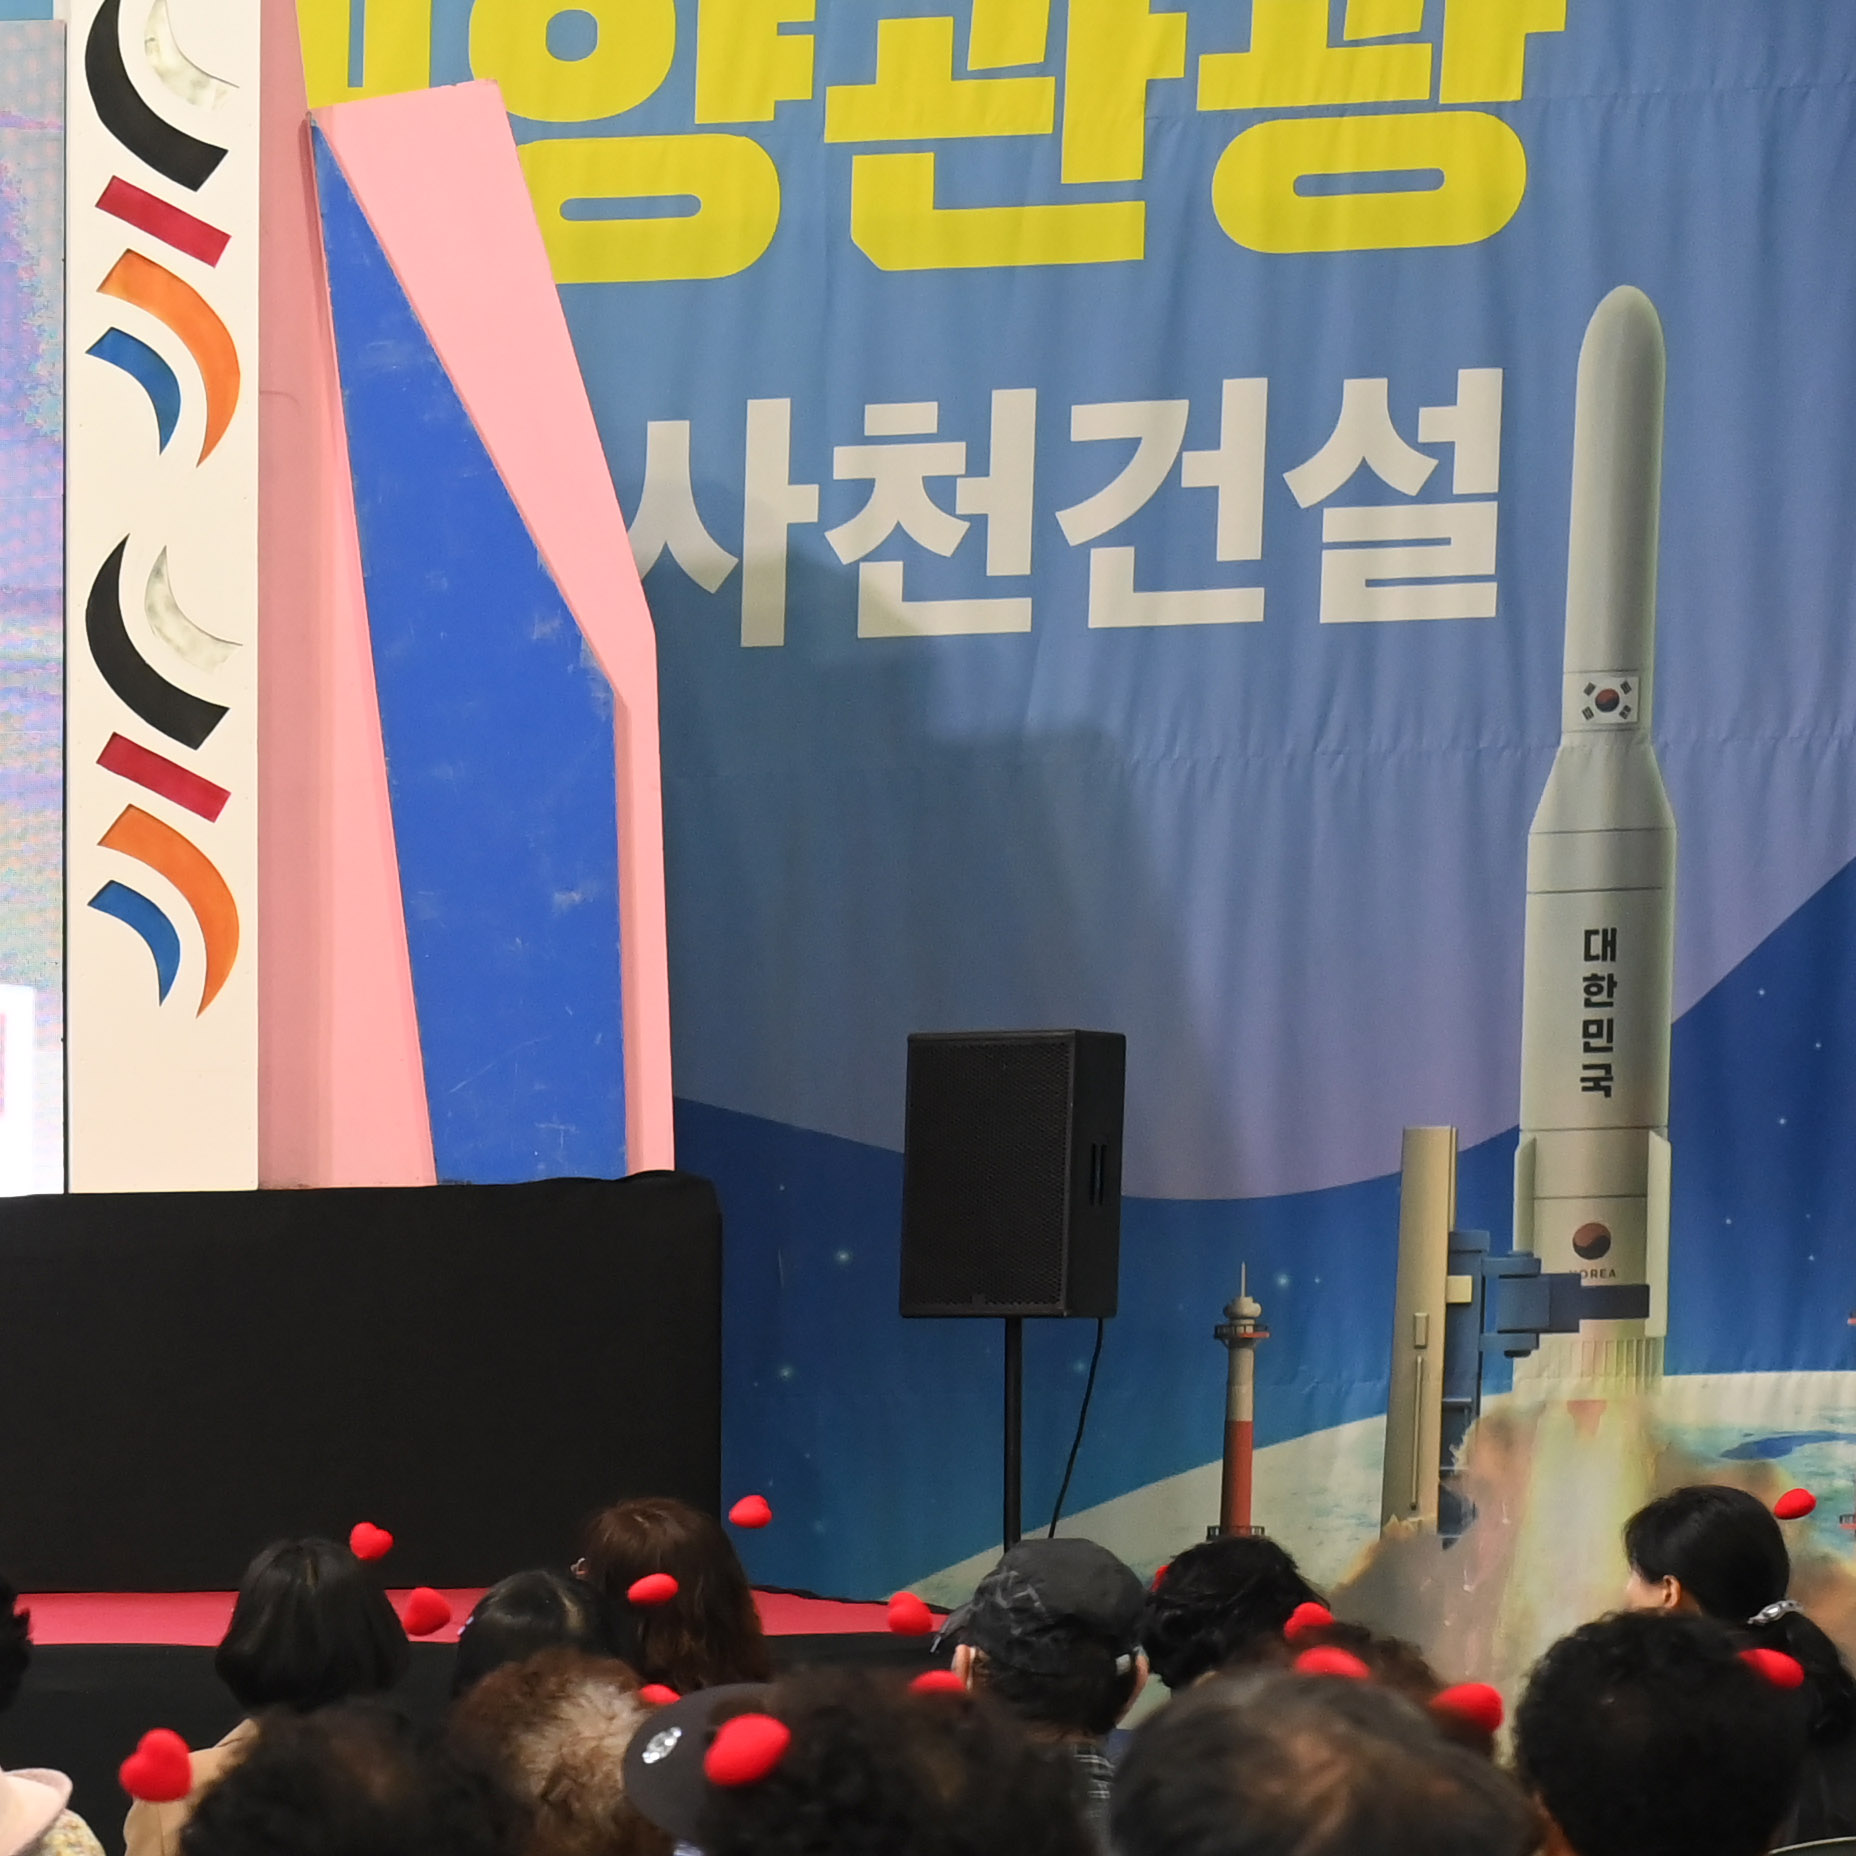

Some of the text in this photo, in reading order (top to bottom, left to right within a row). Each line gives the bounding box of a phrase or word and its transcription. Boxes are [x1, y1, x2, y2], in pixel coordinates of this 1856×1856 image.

[294, 0, 1567, 285] 양관광
[628, 366, 1504, 649] 사천건설
[1580, 927, 1618, 1098] 대한민국
[1569, 1268, 1616, 1280] OREA
